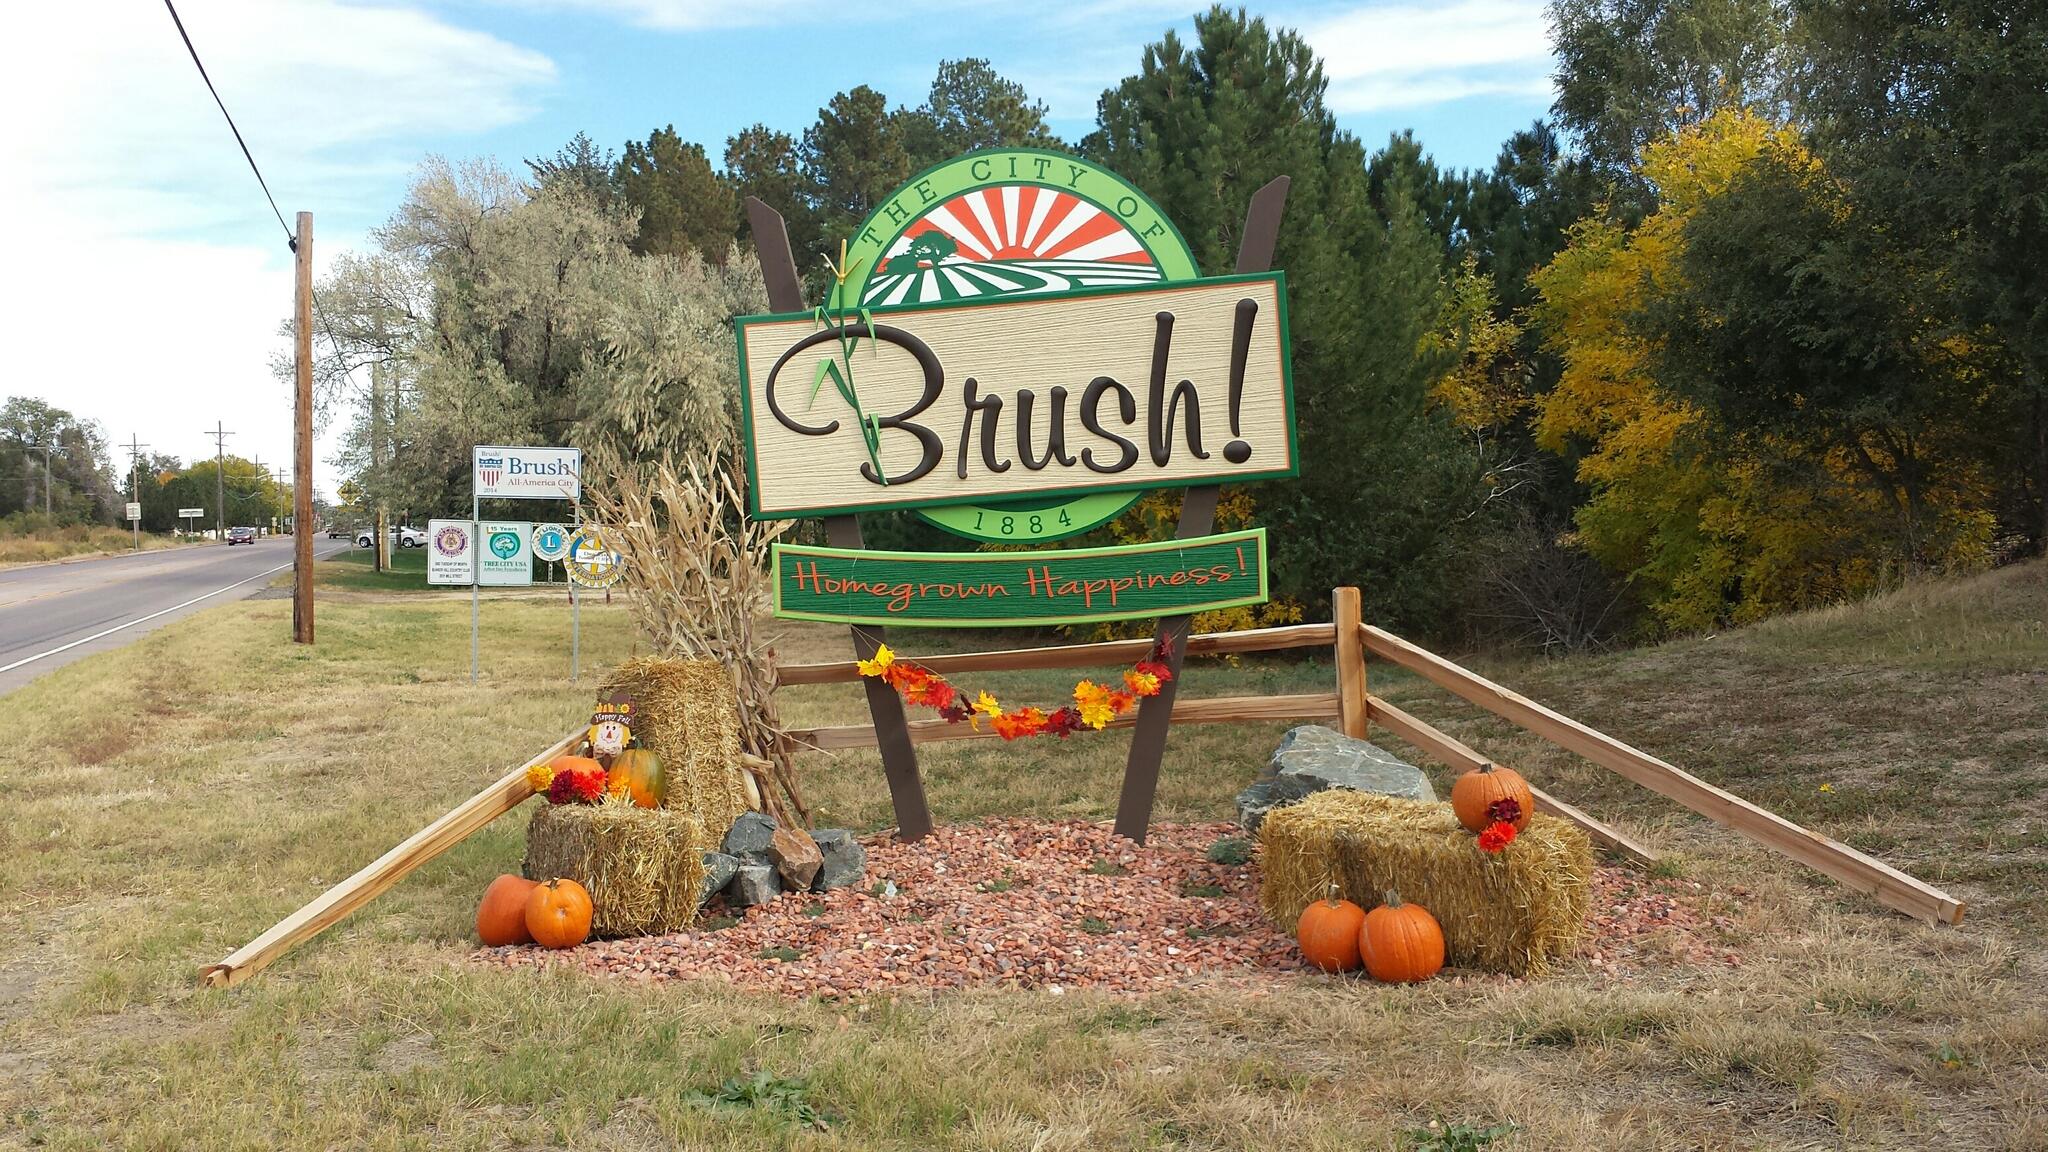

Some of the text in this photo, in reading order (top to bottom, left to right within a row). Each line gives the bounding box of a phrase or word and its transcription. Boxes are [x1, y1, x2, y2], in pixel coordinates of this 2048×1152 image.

[861, 157, 1166, 248] THE CITY OF
[766, 298, 1259, 485] Brush!
[508, 457, 576, 475] Brush!
[508, 478, 574, 488] All-America City
[974, 508, 1071, 535] 1884
[546, 535, 556, 547] L
[792, 546, 1248, 612] Homegrown Happiness!
[595, 713, 631, 724] Happy Fall
